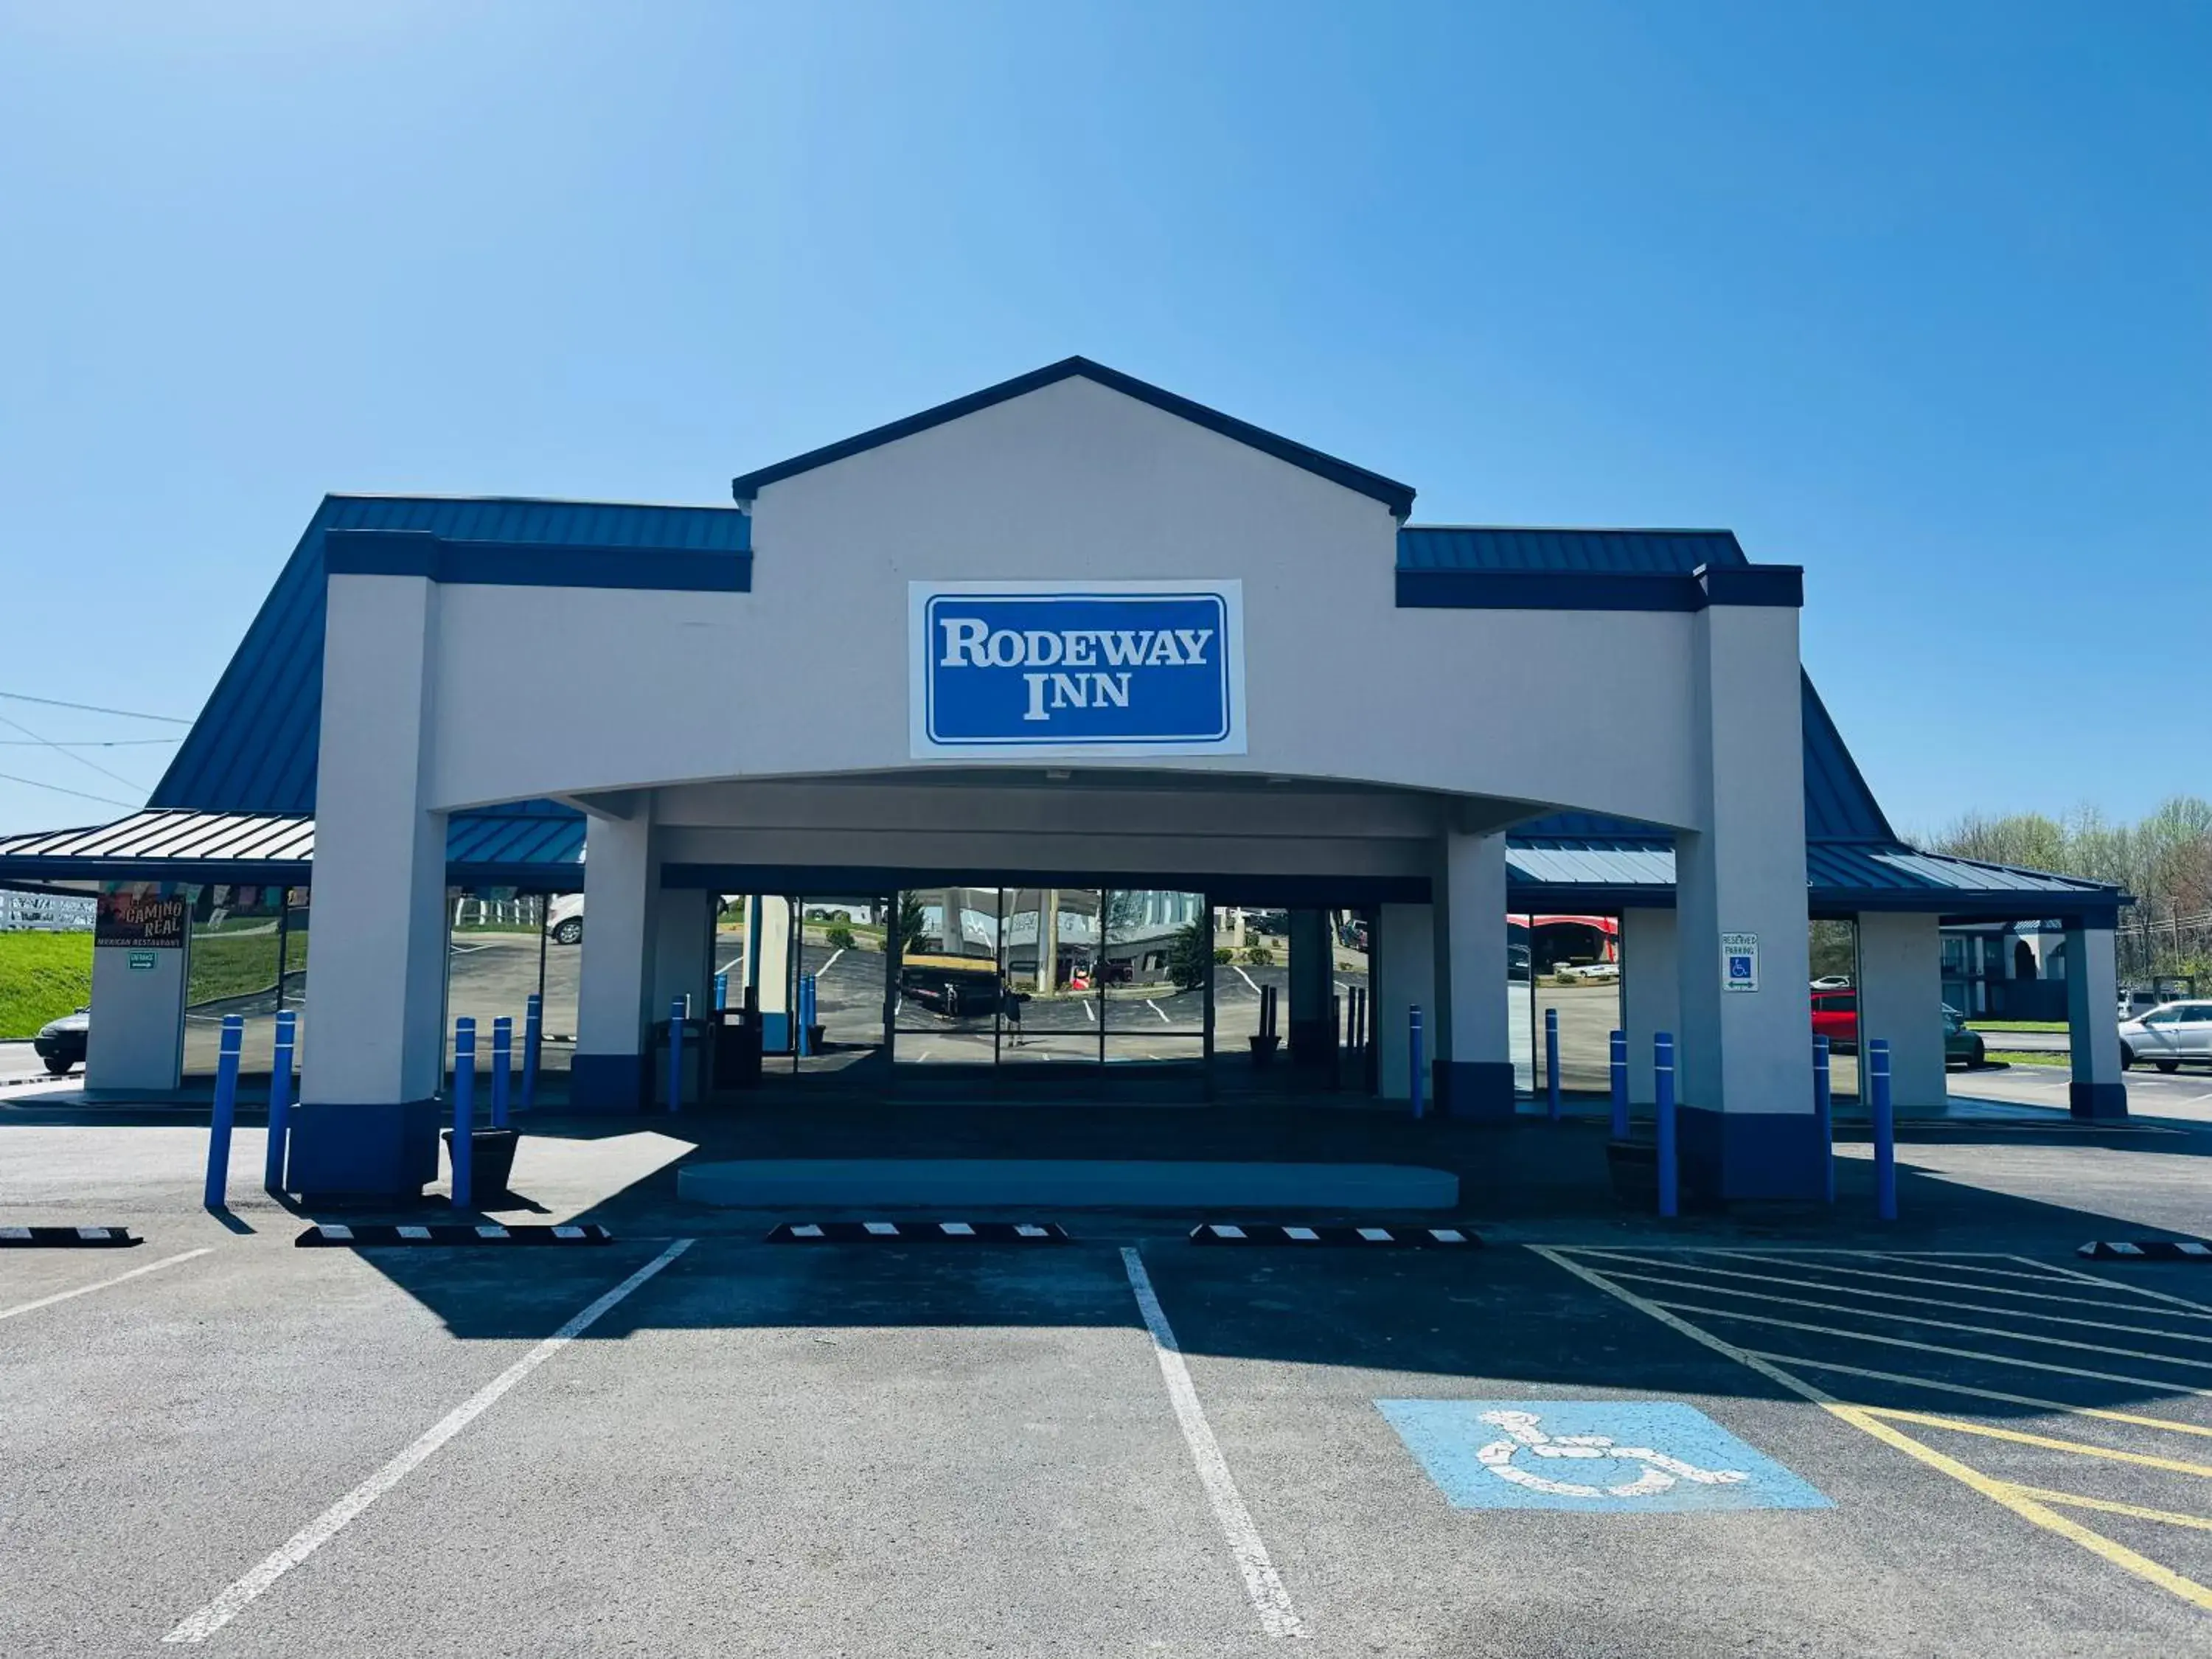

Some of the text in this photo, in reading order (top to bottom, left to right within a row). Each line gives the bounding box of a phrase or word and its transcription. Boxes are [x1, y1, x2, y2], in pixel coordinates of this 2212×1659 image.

[939, 618, 1213, 667] RODEWAY
[1023, 672, 1133, 720] INN
[126, 901, 182, 923] CAMINO
[145, 917, 180, 936] REAL
[1722, 936, 1756, 944] RESERVED
[1725, 946, 1754, 954] PARKING
